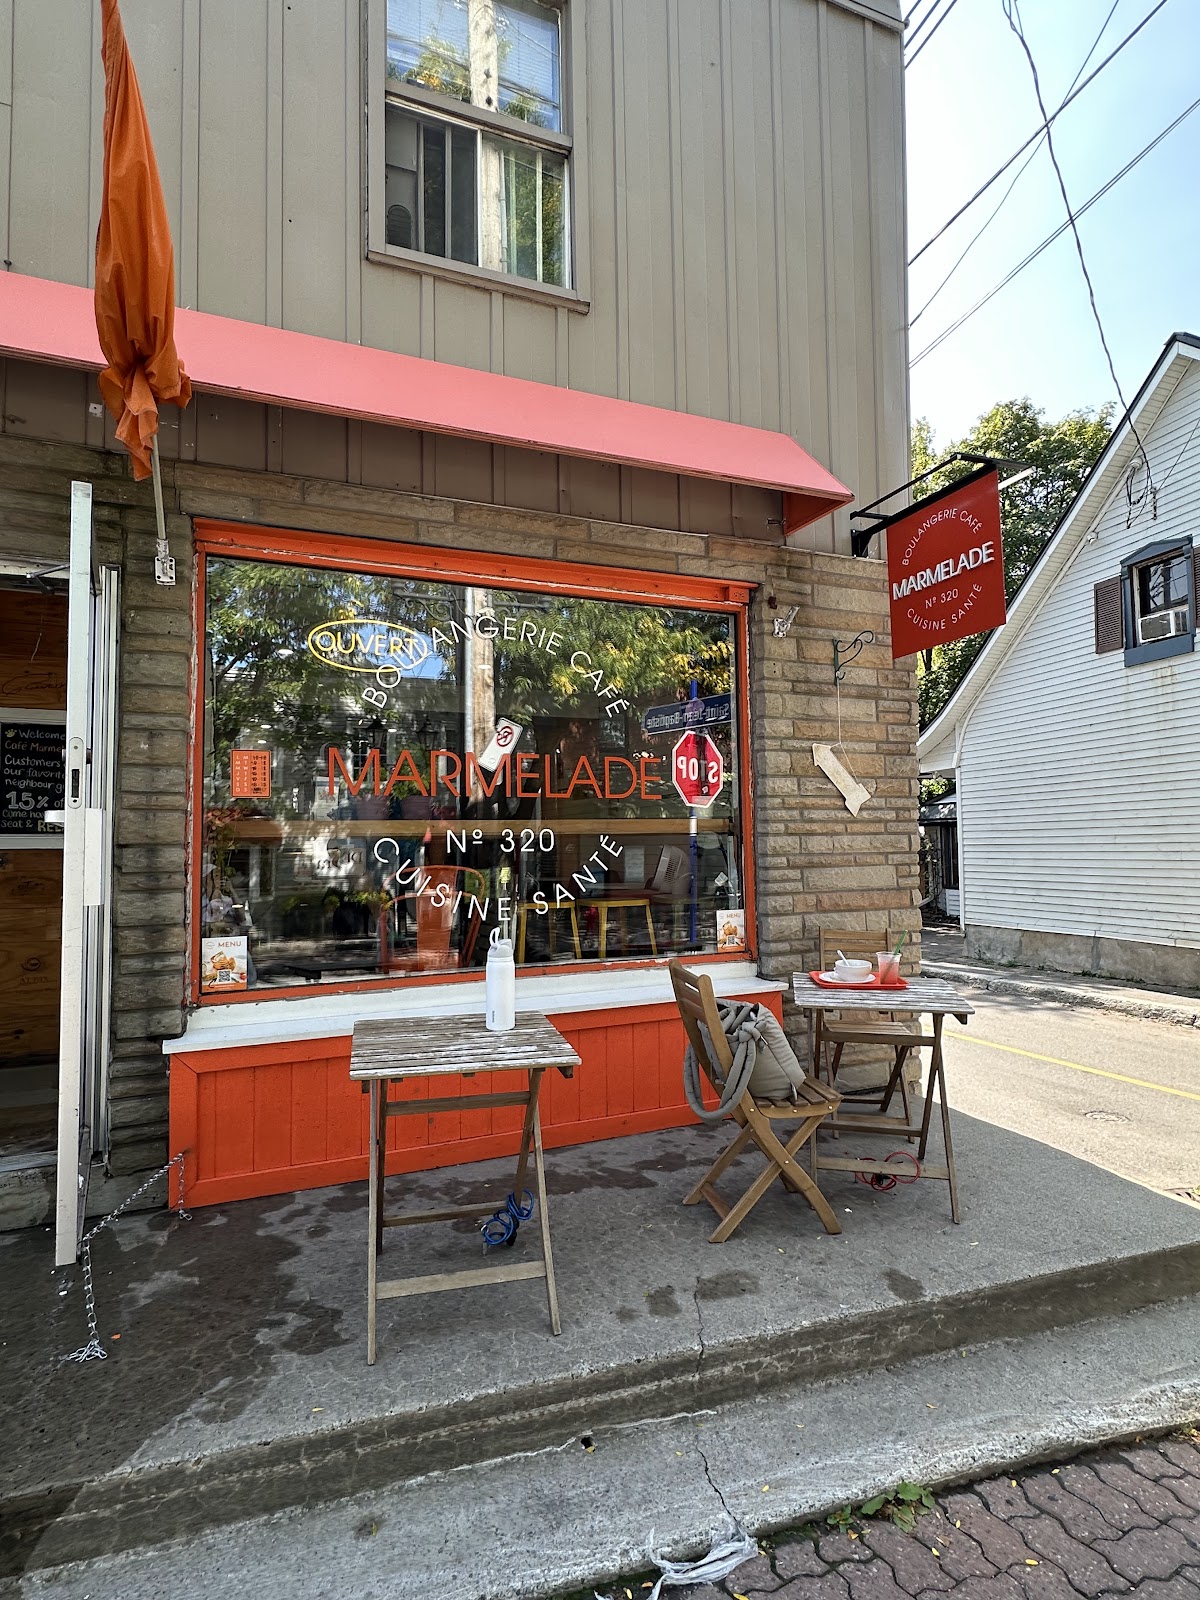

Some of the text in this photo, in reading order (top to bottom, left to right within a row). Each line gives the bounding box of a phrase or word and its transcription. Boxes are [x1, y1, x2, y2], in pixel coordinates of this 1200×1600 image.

[903, 508, 983, 566] BOULANGERIE CAFÉ
[892, 540, 995, 601] MARMELADE
[940, 588, 959, 604] 320
[907, 608, 946, 631] CUISINE
[315, 631, 419, 659] OUVERT
[361, 614, 631, 718] BOULANGERIE CAFÉ
[4, 768, 24, 776] our
[5, 754, 61, 768] Customers
[327, 746, 663, 800] MARMELADE
[5, 779, 54, 789] neighbour
[6, 791, 49, 811] 15%
[499, 828, 555, 853] 320
[373, 834, 624, 921] CUISINE SANTÉ
[217, 940, 242, 948] MENU
